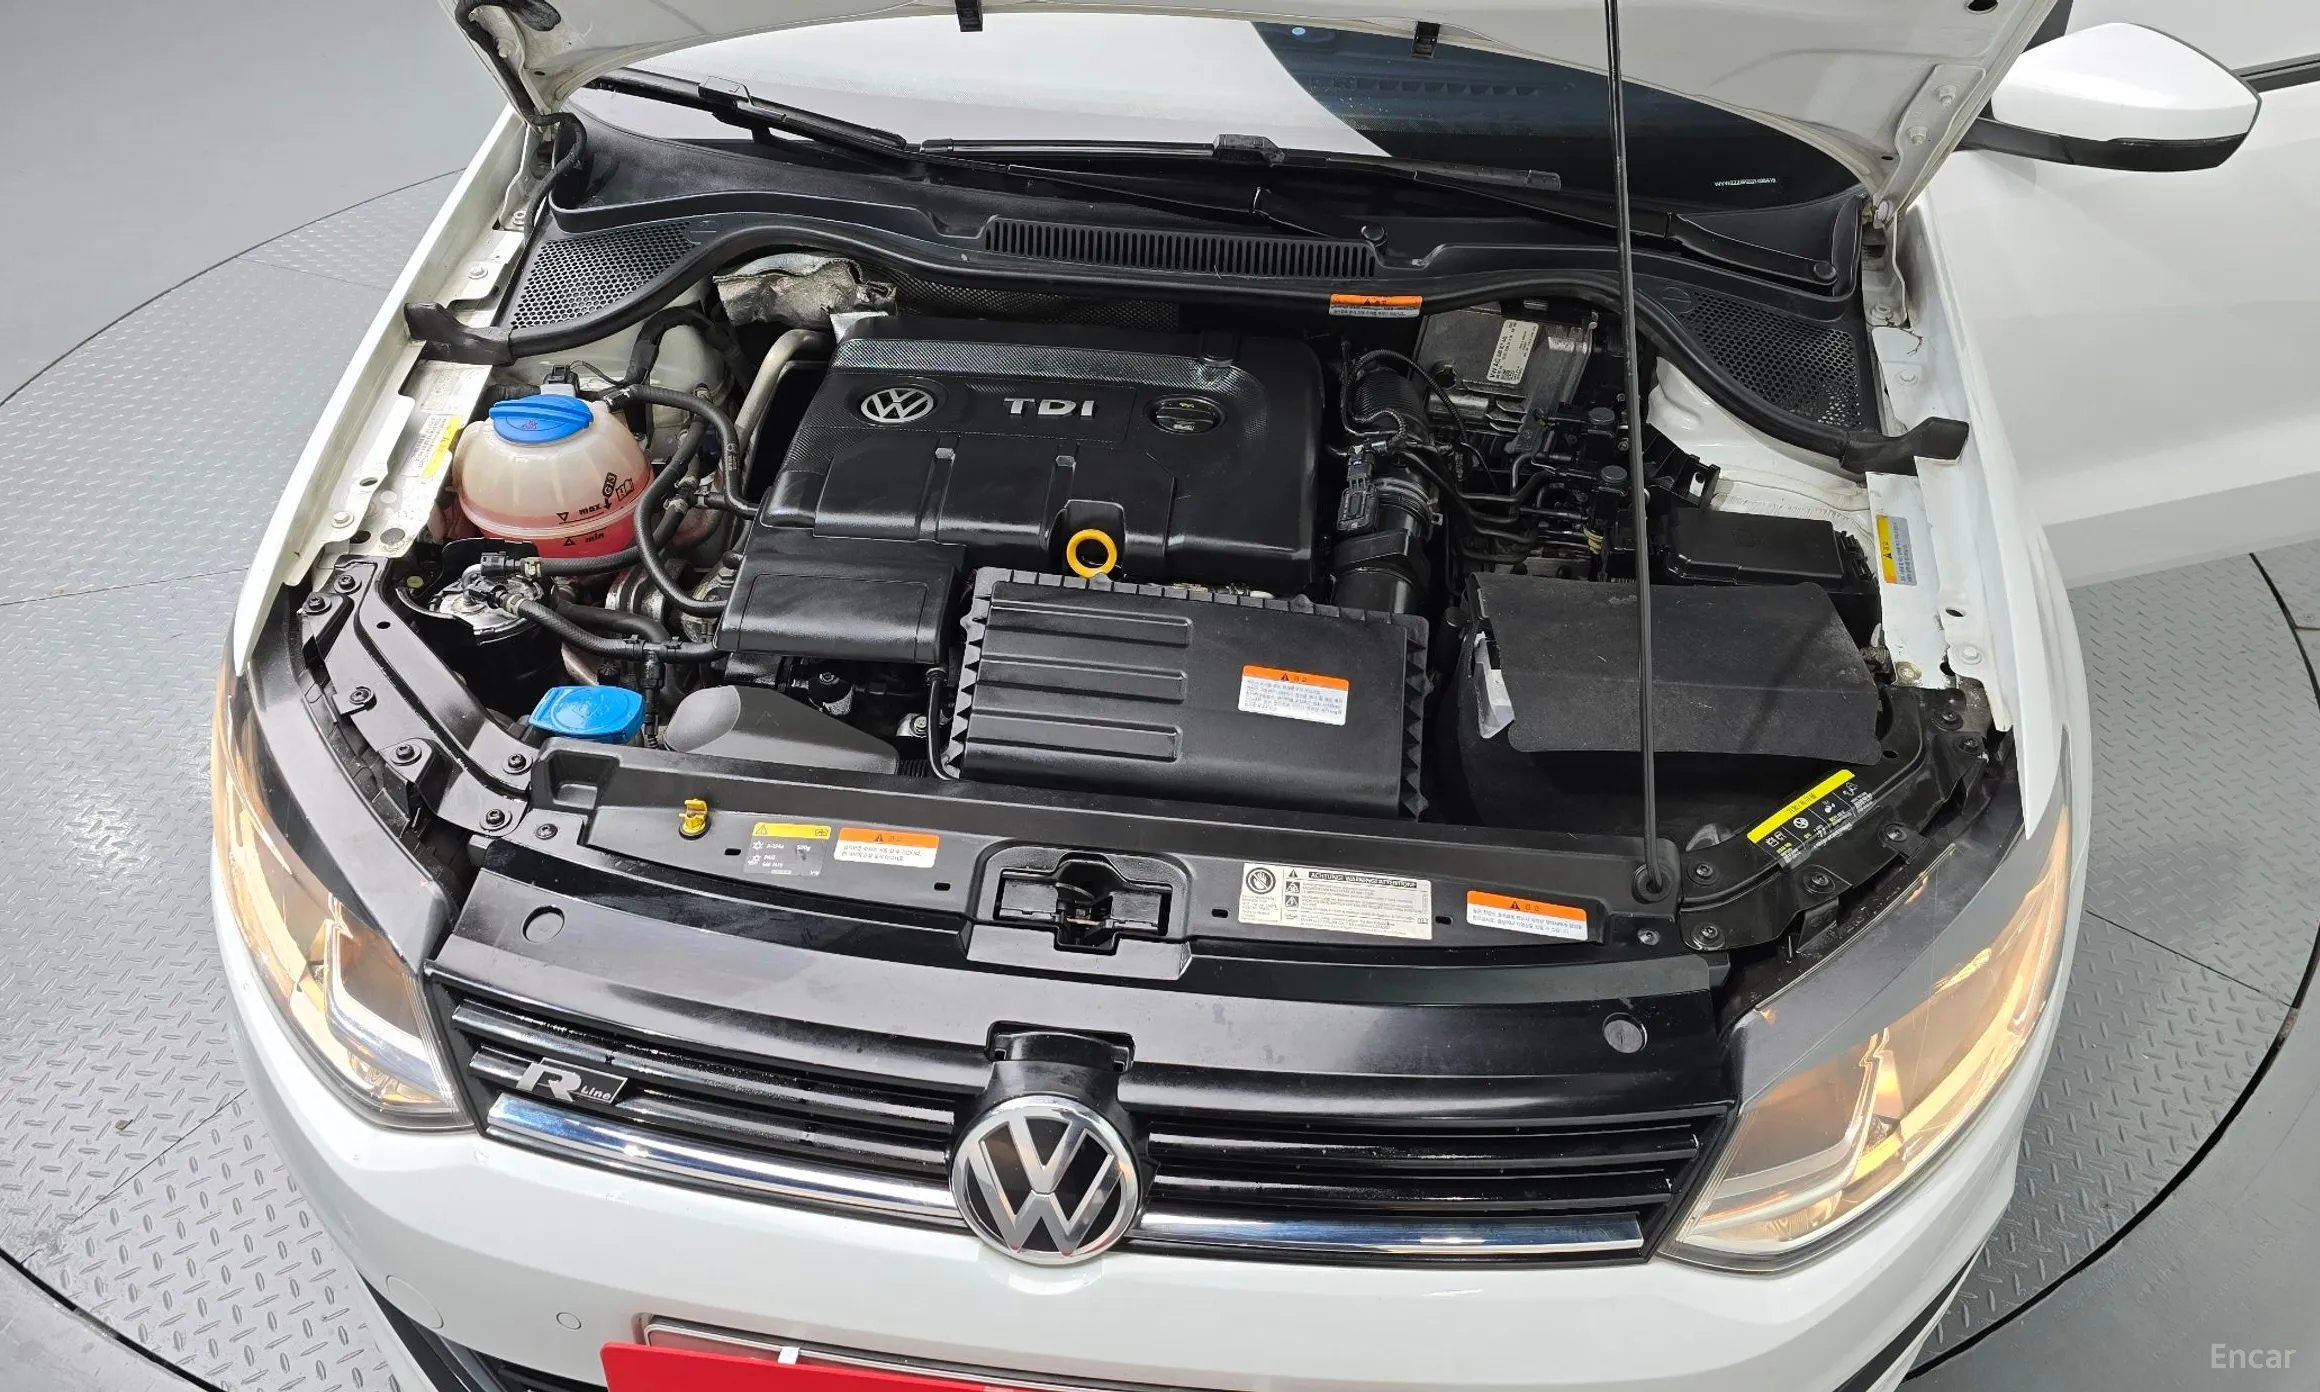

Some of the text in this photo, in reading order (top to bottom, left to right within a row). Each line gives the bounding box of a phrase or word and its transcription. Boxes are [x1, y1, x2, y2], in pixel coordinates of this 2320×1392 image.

[1003, 397, 1096, 419] TDI
[578, 503, 602, 516] max
[585, 532, 605, 544] min
[515, 1062, 612, 1103] R Line
